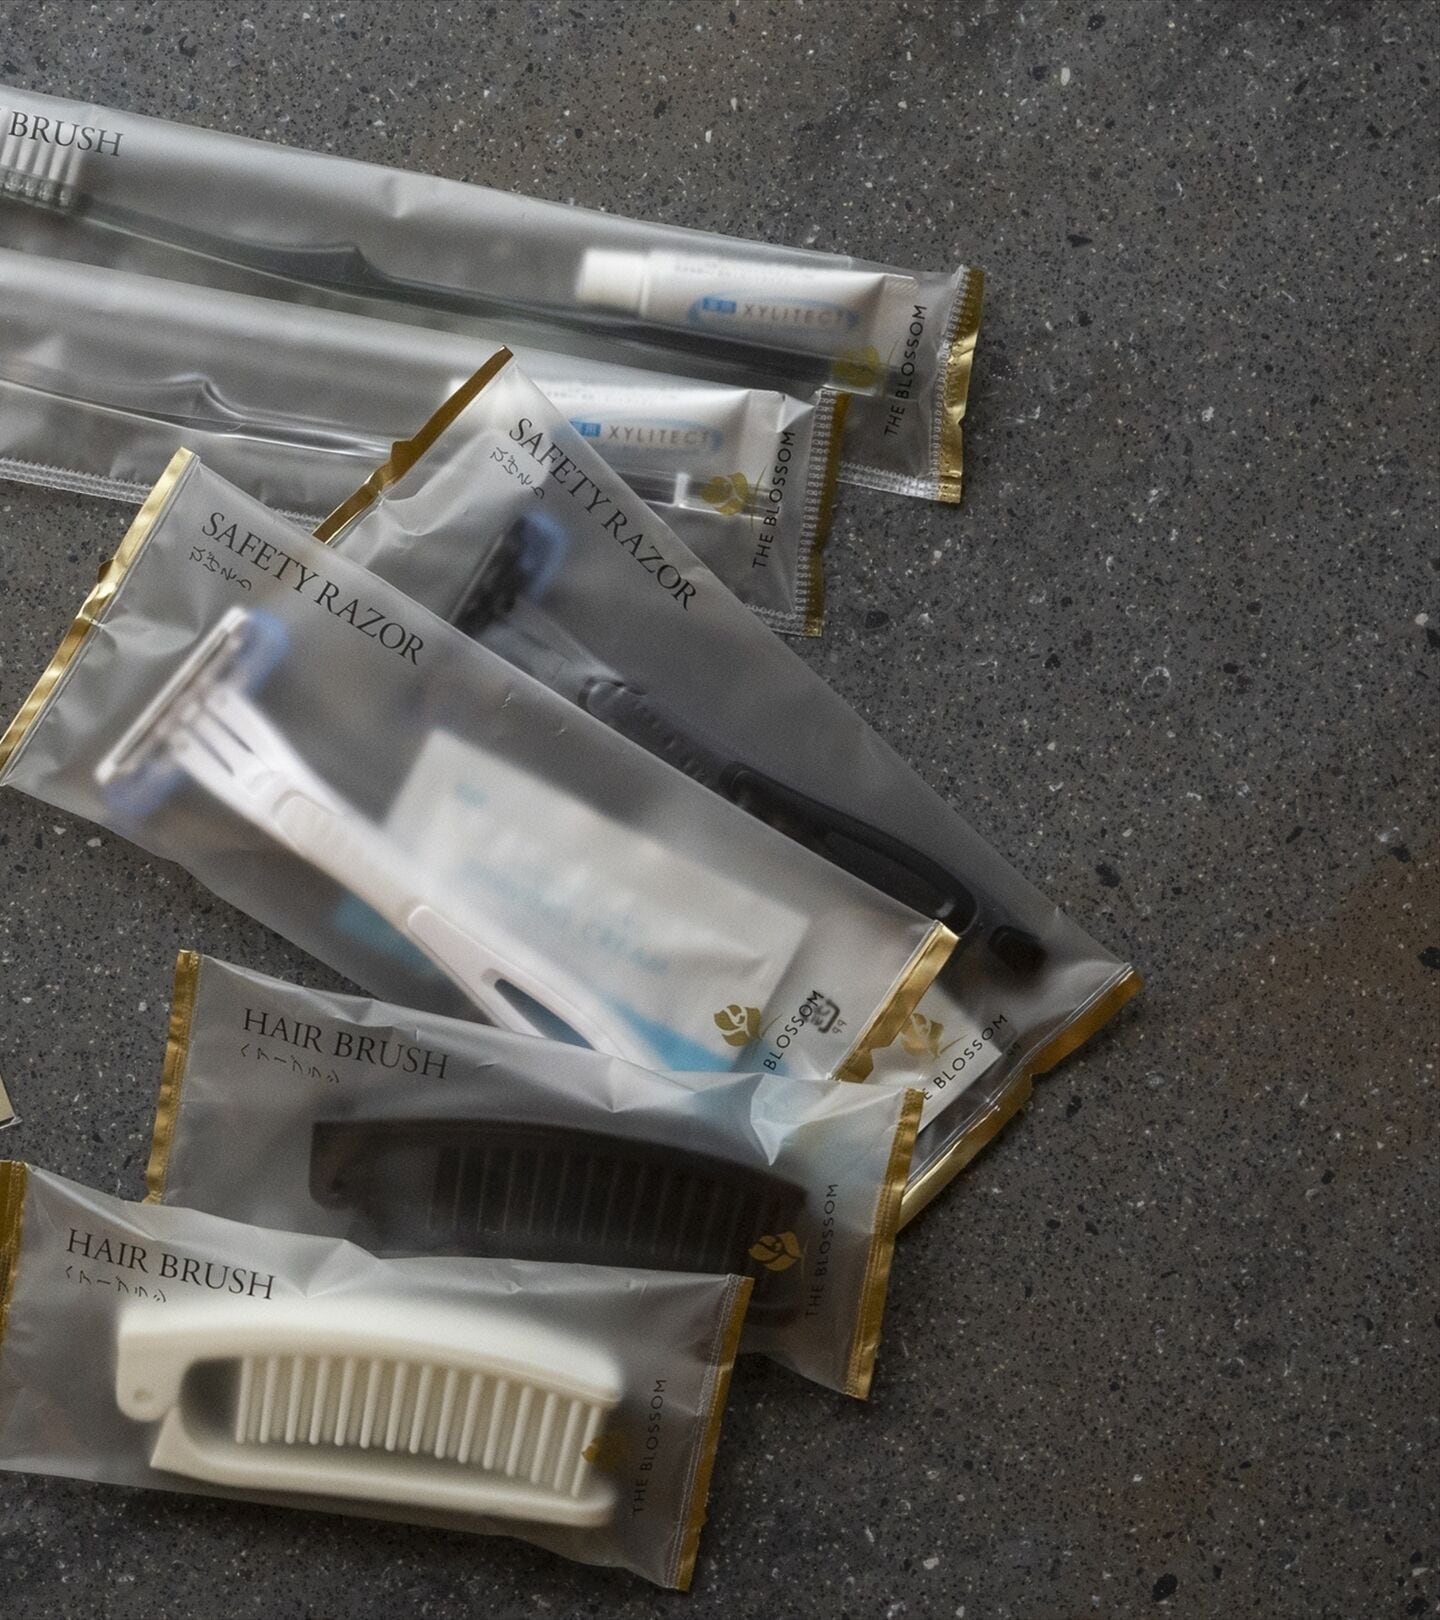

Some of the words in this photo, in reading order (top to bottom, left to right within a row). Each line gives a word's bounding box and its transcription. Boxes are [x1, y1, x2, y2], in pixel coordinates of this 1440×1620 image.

[9, 111, 124, 156] BRUSH
[884, 405, 905, 436] THE
[895, 305, 926, 399] BLOSSOM
[489, 446, 545, 498] ひげそり
[752, 536, 772, 568] THE
[764, 430, 795, 527] BLOSSOM
[508, 417, 612, 510] SAFETY
[603, 510, 698, 611] RAZOR
[189, 545, 252, 591] ひげそり
[201, 511, 323, 595] SAFETY
[314, 581, 425, 666] RAZOR
[243, 1008, 322, 1052] HAIR
[333, 1031, 449, 1080] BRUSH
[763, 989, 826, 1072] BLOSSOM
[933, 1014, 1008, 1089] BLOSSOM
[67, 1228, 148, 1274] HAIR
[160, 1252, 276, 1300] BRUSH
[805, 1289, 822, 1318] THE
[814, 1183, 839, 1281] BLOSSOM
[640, 1379, 667, 1470] BLOSSOM
[633, 1477, 648, 1516] THE
